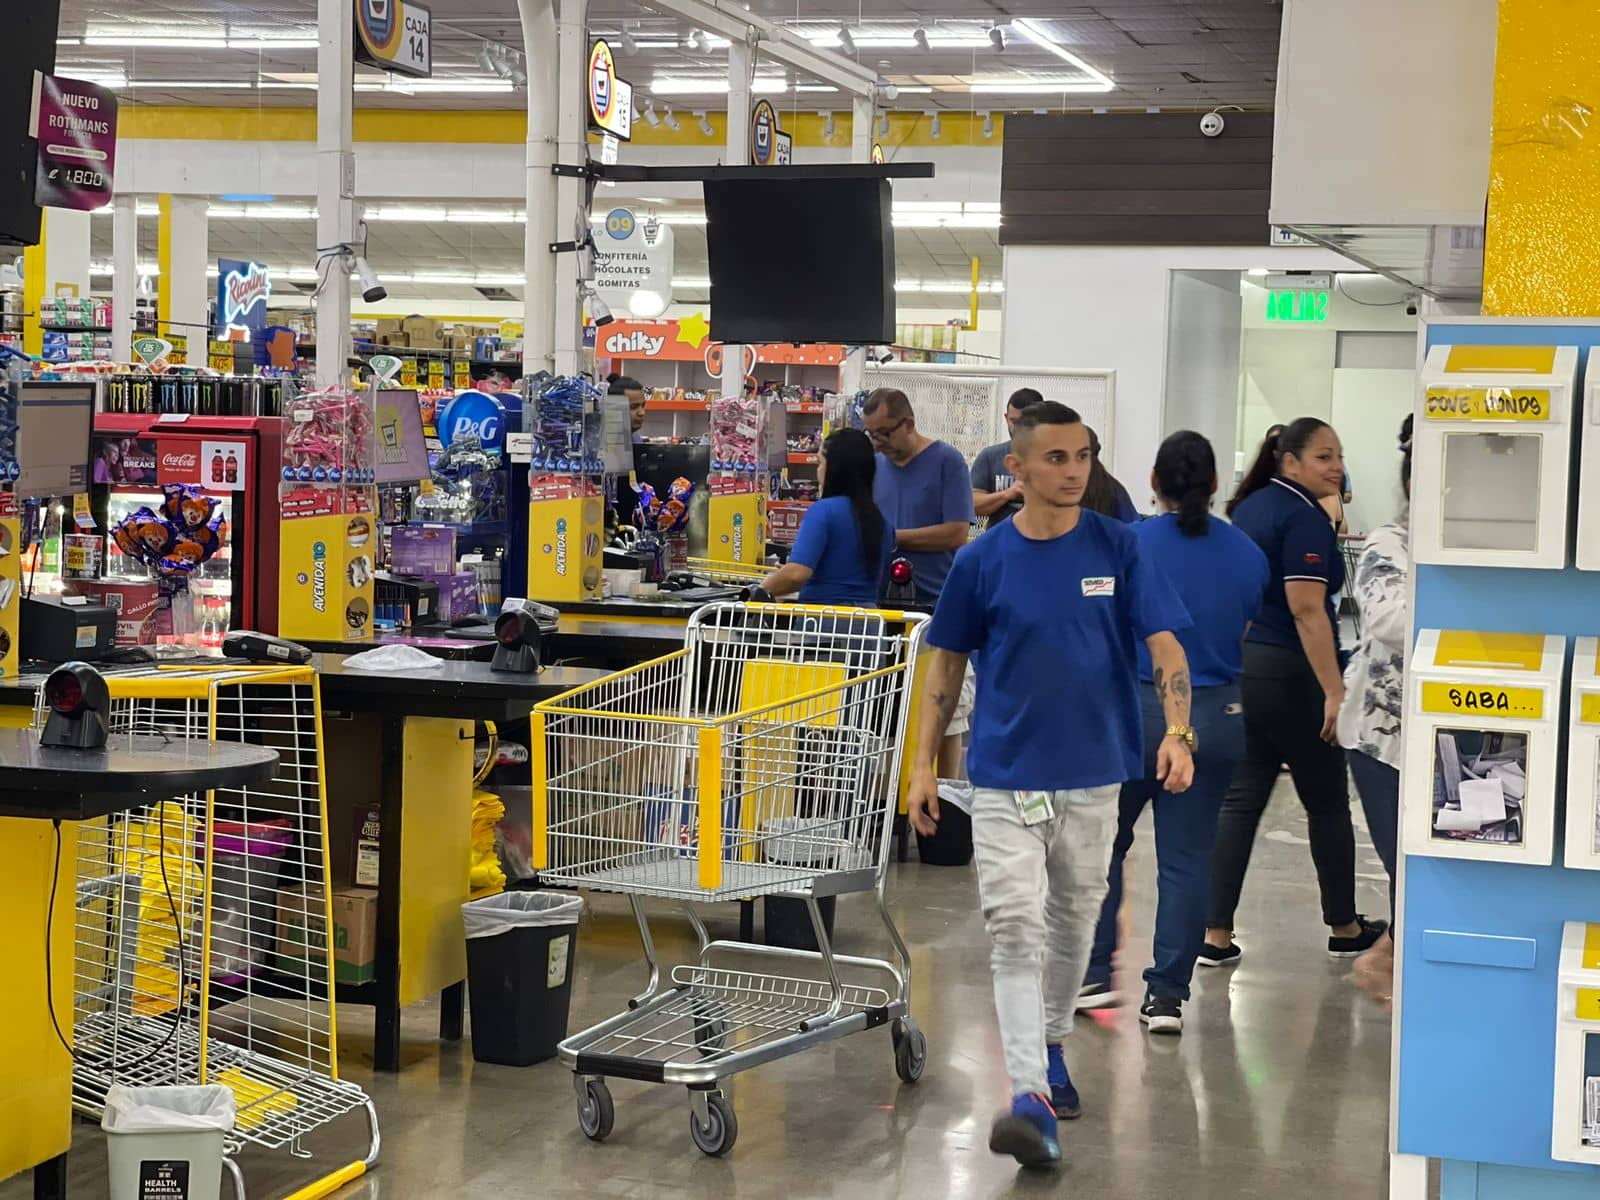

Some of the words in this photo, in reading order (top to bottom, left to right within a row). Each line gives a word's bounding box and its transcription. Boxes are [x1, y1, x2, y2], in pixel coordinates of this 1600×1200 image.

[405, 16, 428, 36] CAJA
[409, 36, 424, 63] 14
[62, 93, 99, 110] NUEVO
[49, 114, 109, 135] ROTHMANS
[66, 169, 103, 186] 1.800
[607, 216, 632, 232] 09
[596, 251, 648, 261] ONFITERÍA
[594, 265, 651, 274] HOCOLATES
[597, 279, 641, 288] GOMITAS
[605, 331, 665, 356] chiky
[452, 416, 498, 441] P&G
[123, 460, 156, 469] BREAKS
[144, 1179, 177, 1187] HEALTH
